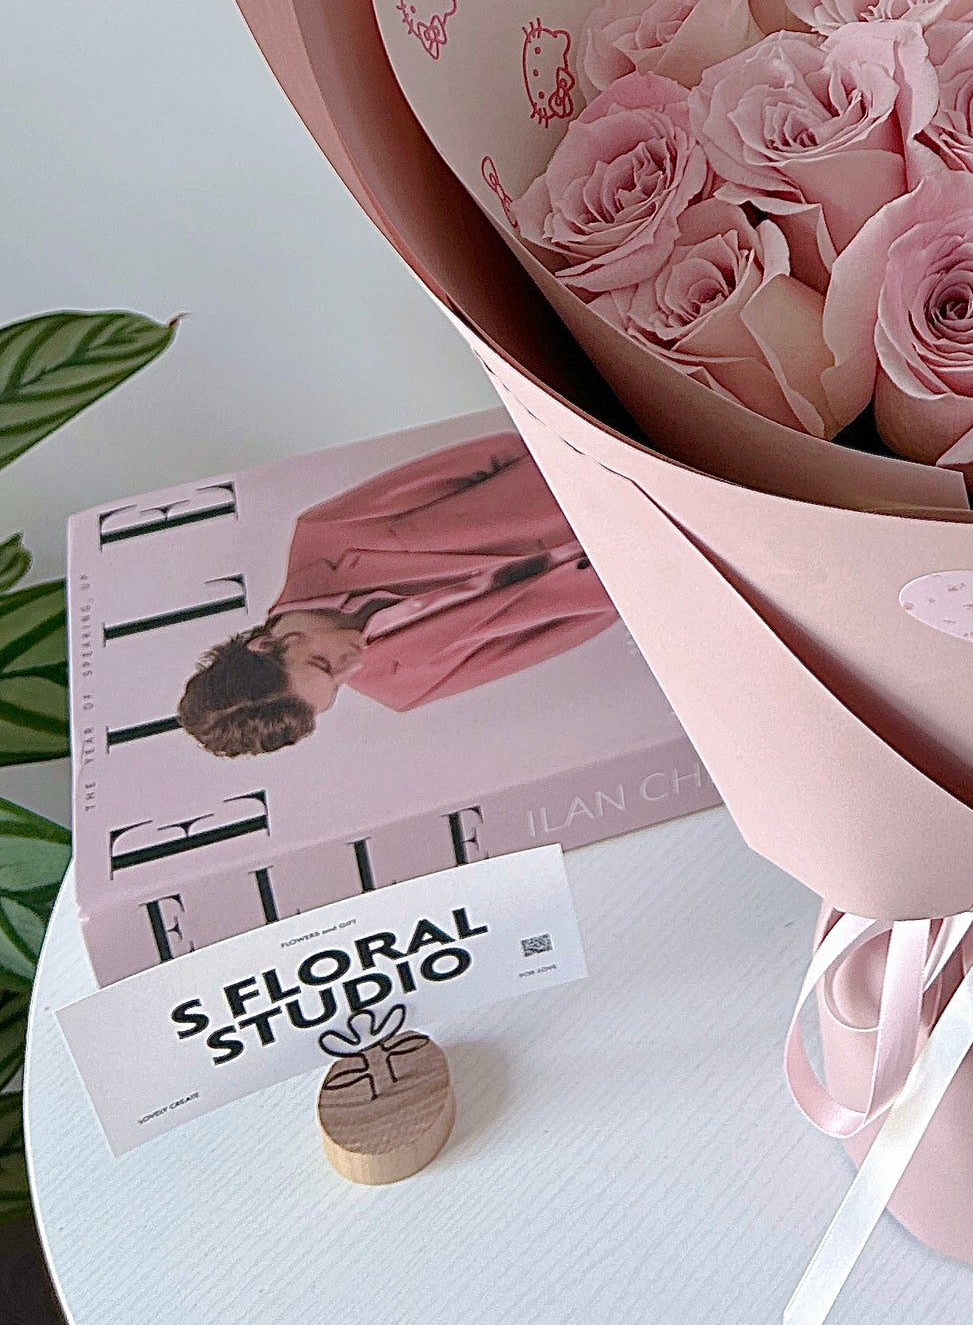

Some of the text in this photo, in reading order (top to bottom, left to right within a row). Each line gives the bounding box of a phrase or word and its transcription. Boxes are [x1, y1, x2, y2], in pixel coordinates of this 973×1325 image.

[83, 727, 95, 765] YEAR
[84, 782, 97, 812] THE
[527, 784, 626, 838] ILAN
[280, 931, 320, 948] FLOWERS
[171, 907, 489, 1040] S FLORAL
[206, 947, 472, 1066] STUDIO
